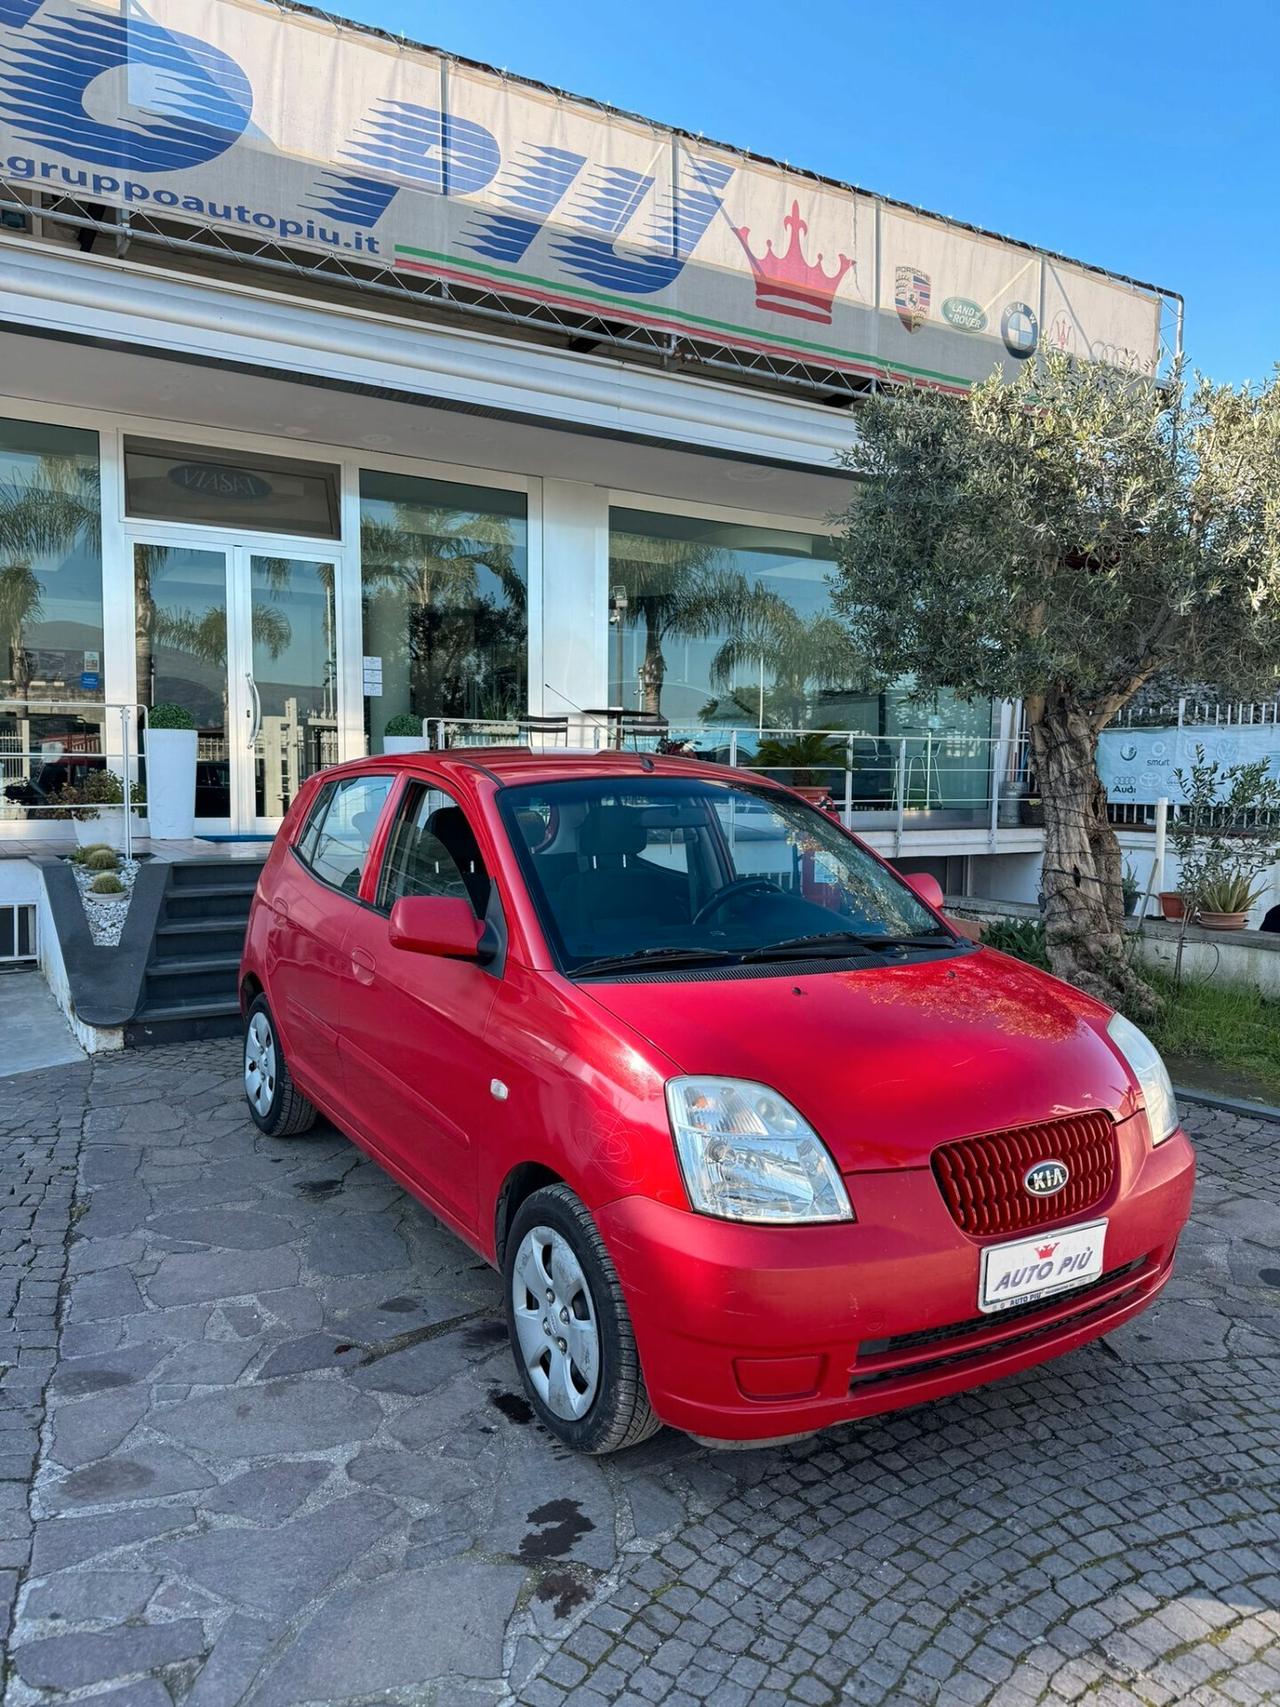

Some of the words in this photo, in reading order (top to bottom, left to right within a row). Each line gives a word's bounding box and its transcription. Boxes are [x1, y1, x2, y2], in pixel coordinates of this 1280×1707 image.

[951, 303, 975, 317] LAND
[953, 313, 981, 329] ROVER
[1147, 759, 1169, 767] smart
[1112, 785, 1136, 793] Audi
[1033, 1168, 1063, 1190] KIA
[993, 1261, 1054, 1292] AUTO
[1057, 1247, 1093, 1275] PIÙ
[1009, 1295, 1028, 1306] AUTO
